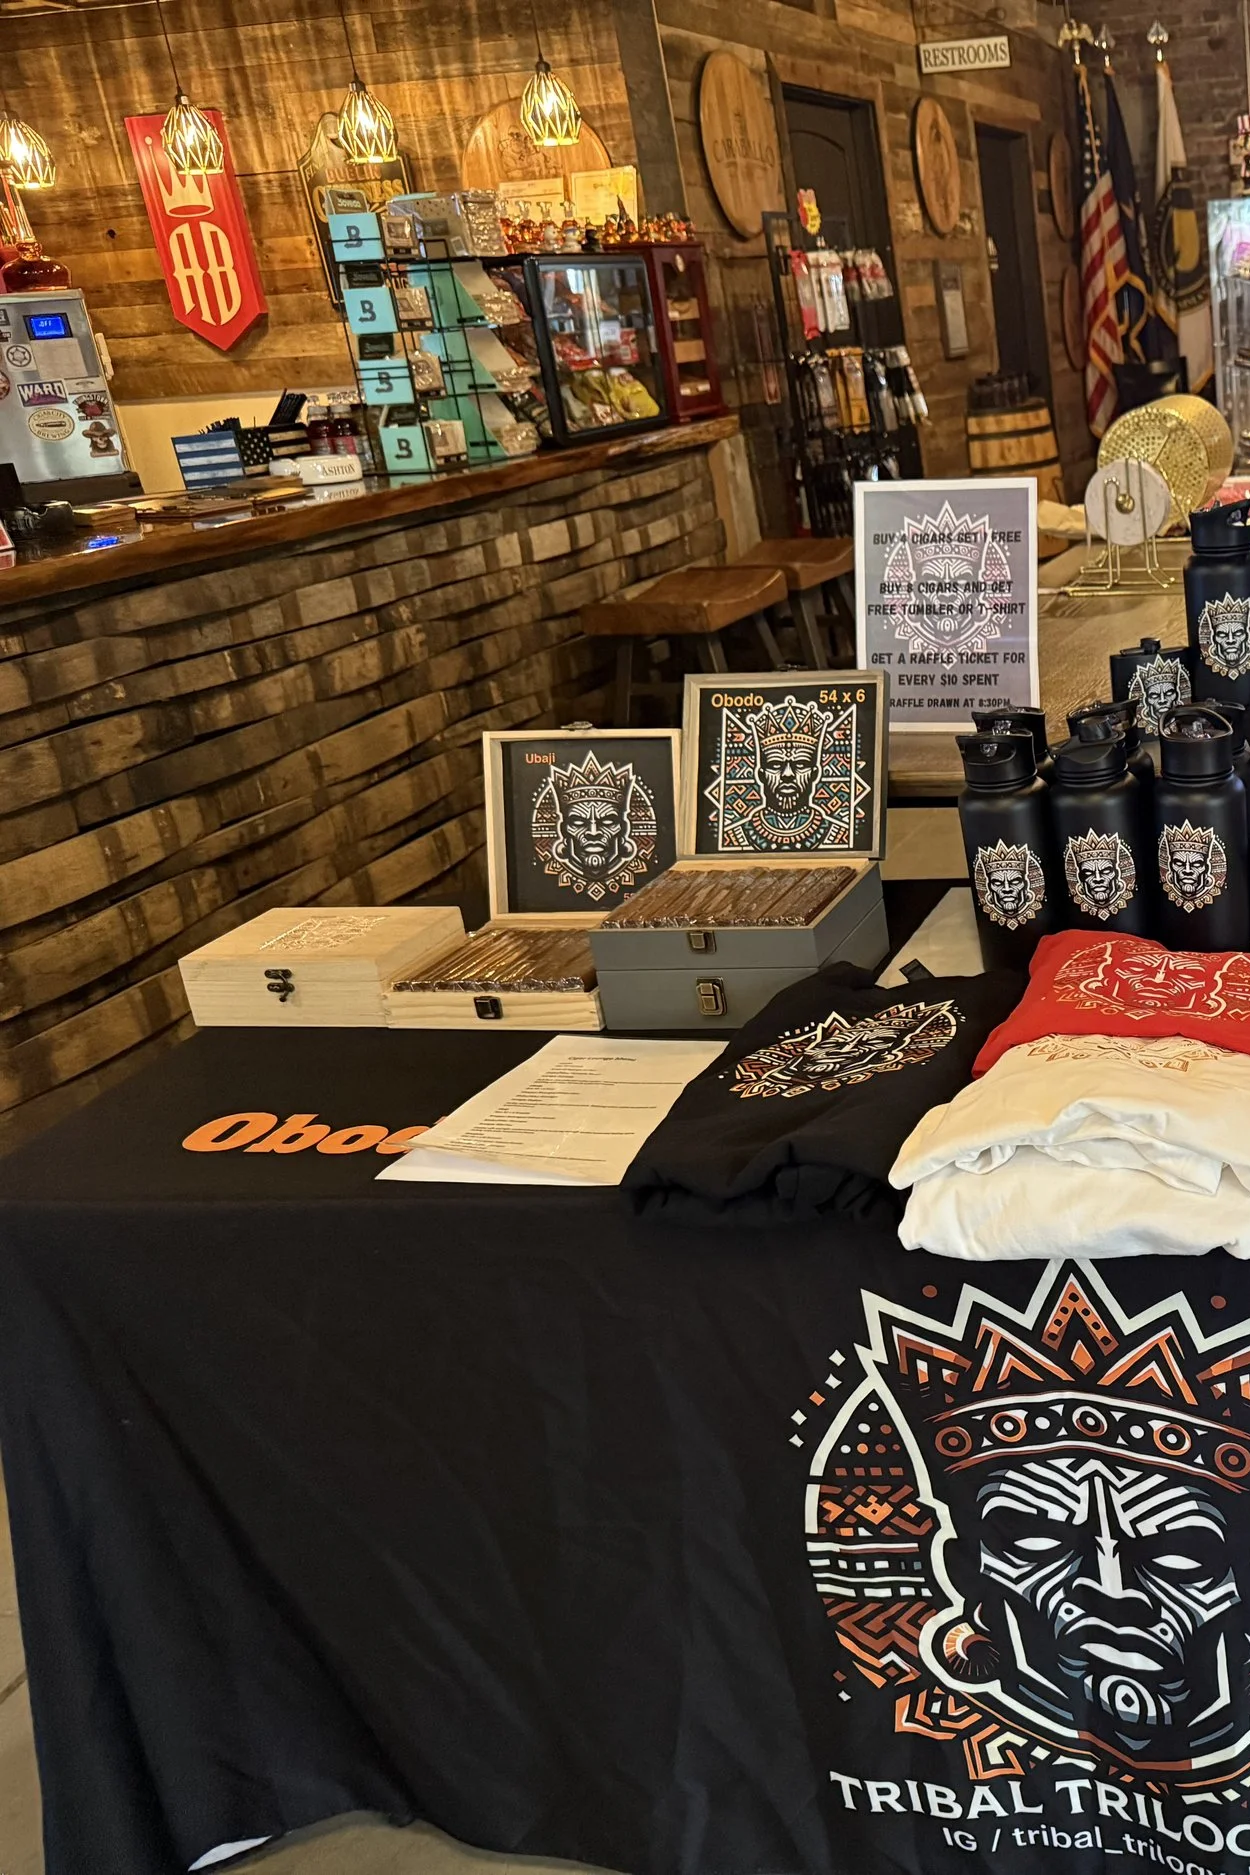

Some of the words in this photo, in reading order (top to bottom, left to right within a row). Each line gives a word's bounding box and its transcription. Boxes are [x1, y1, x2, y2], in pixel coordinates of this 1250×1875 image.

[922, 42, 1008, 68] RESTROOMS
[326, 165, 382, 184] DUBLIN
[19, 382, 65, 401] WARD
[321, 462, 356, 476] ASHTON
[873, 532, 898, 545] BUY
[900, 532, 907, 545] 4
[911, 531, 953, 544] CIGARS
[956, 531, 979, 544] GET
[992, 530, 1022, 543] FREE
[879, 582, 902, 595] BUY
[917, 581, 959, 594] CIGARS
[963, 581, 987, 593] AND
[991, 581, 1014, 593] GET
[867, 605, 897, 616] FREE
[901, 604, 954, 616] TUMBLER
[958, 603, 973, 615] OR
[977, 602, 1026, 615] T-SHIRT
[871, 653, 893, 665] GET
[897, 653, 906, 665] A
[910, 652, 954, 665] RAFFLE
[959, 652, 999, 664] TICKET
[1003, 652, 1026, 664] FOR
[898, 674, 936, 686] EVERY
[940, 673, 958, 686] $10
[962, 673, 999, 686] SPENT
[711, 692, 765, 708] Obodo
[819, 689, 838, 704] 54
[842, 692, 852, 703] x
[855, 688, 866, 703] 6
[890, 698, 924, 708] RAFFLE
[927, 697, 960, 708] DRAWN
[963, 697, 974, 707] AT
[525, 752, 556, 766] Ubaji
[829, 1770, 1044, 1820] TRIBAL
[942, 1827, 978, 1852] IG
[991, 1828, 1002, 1853] /
